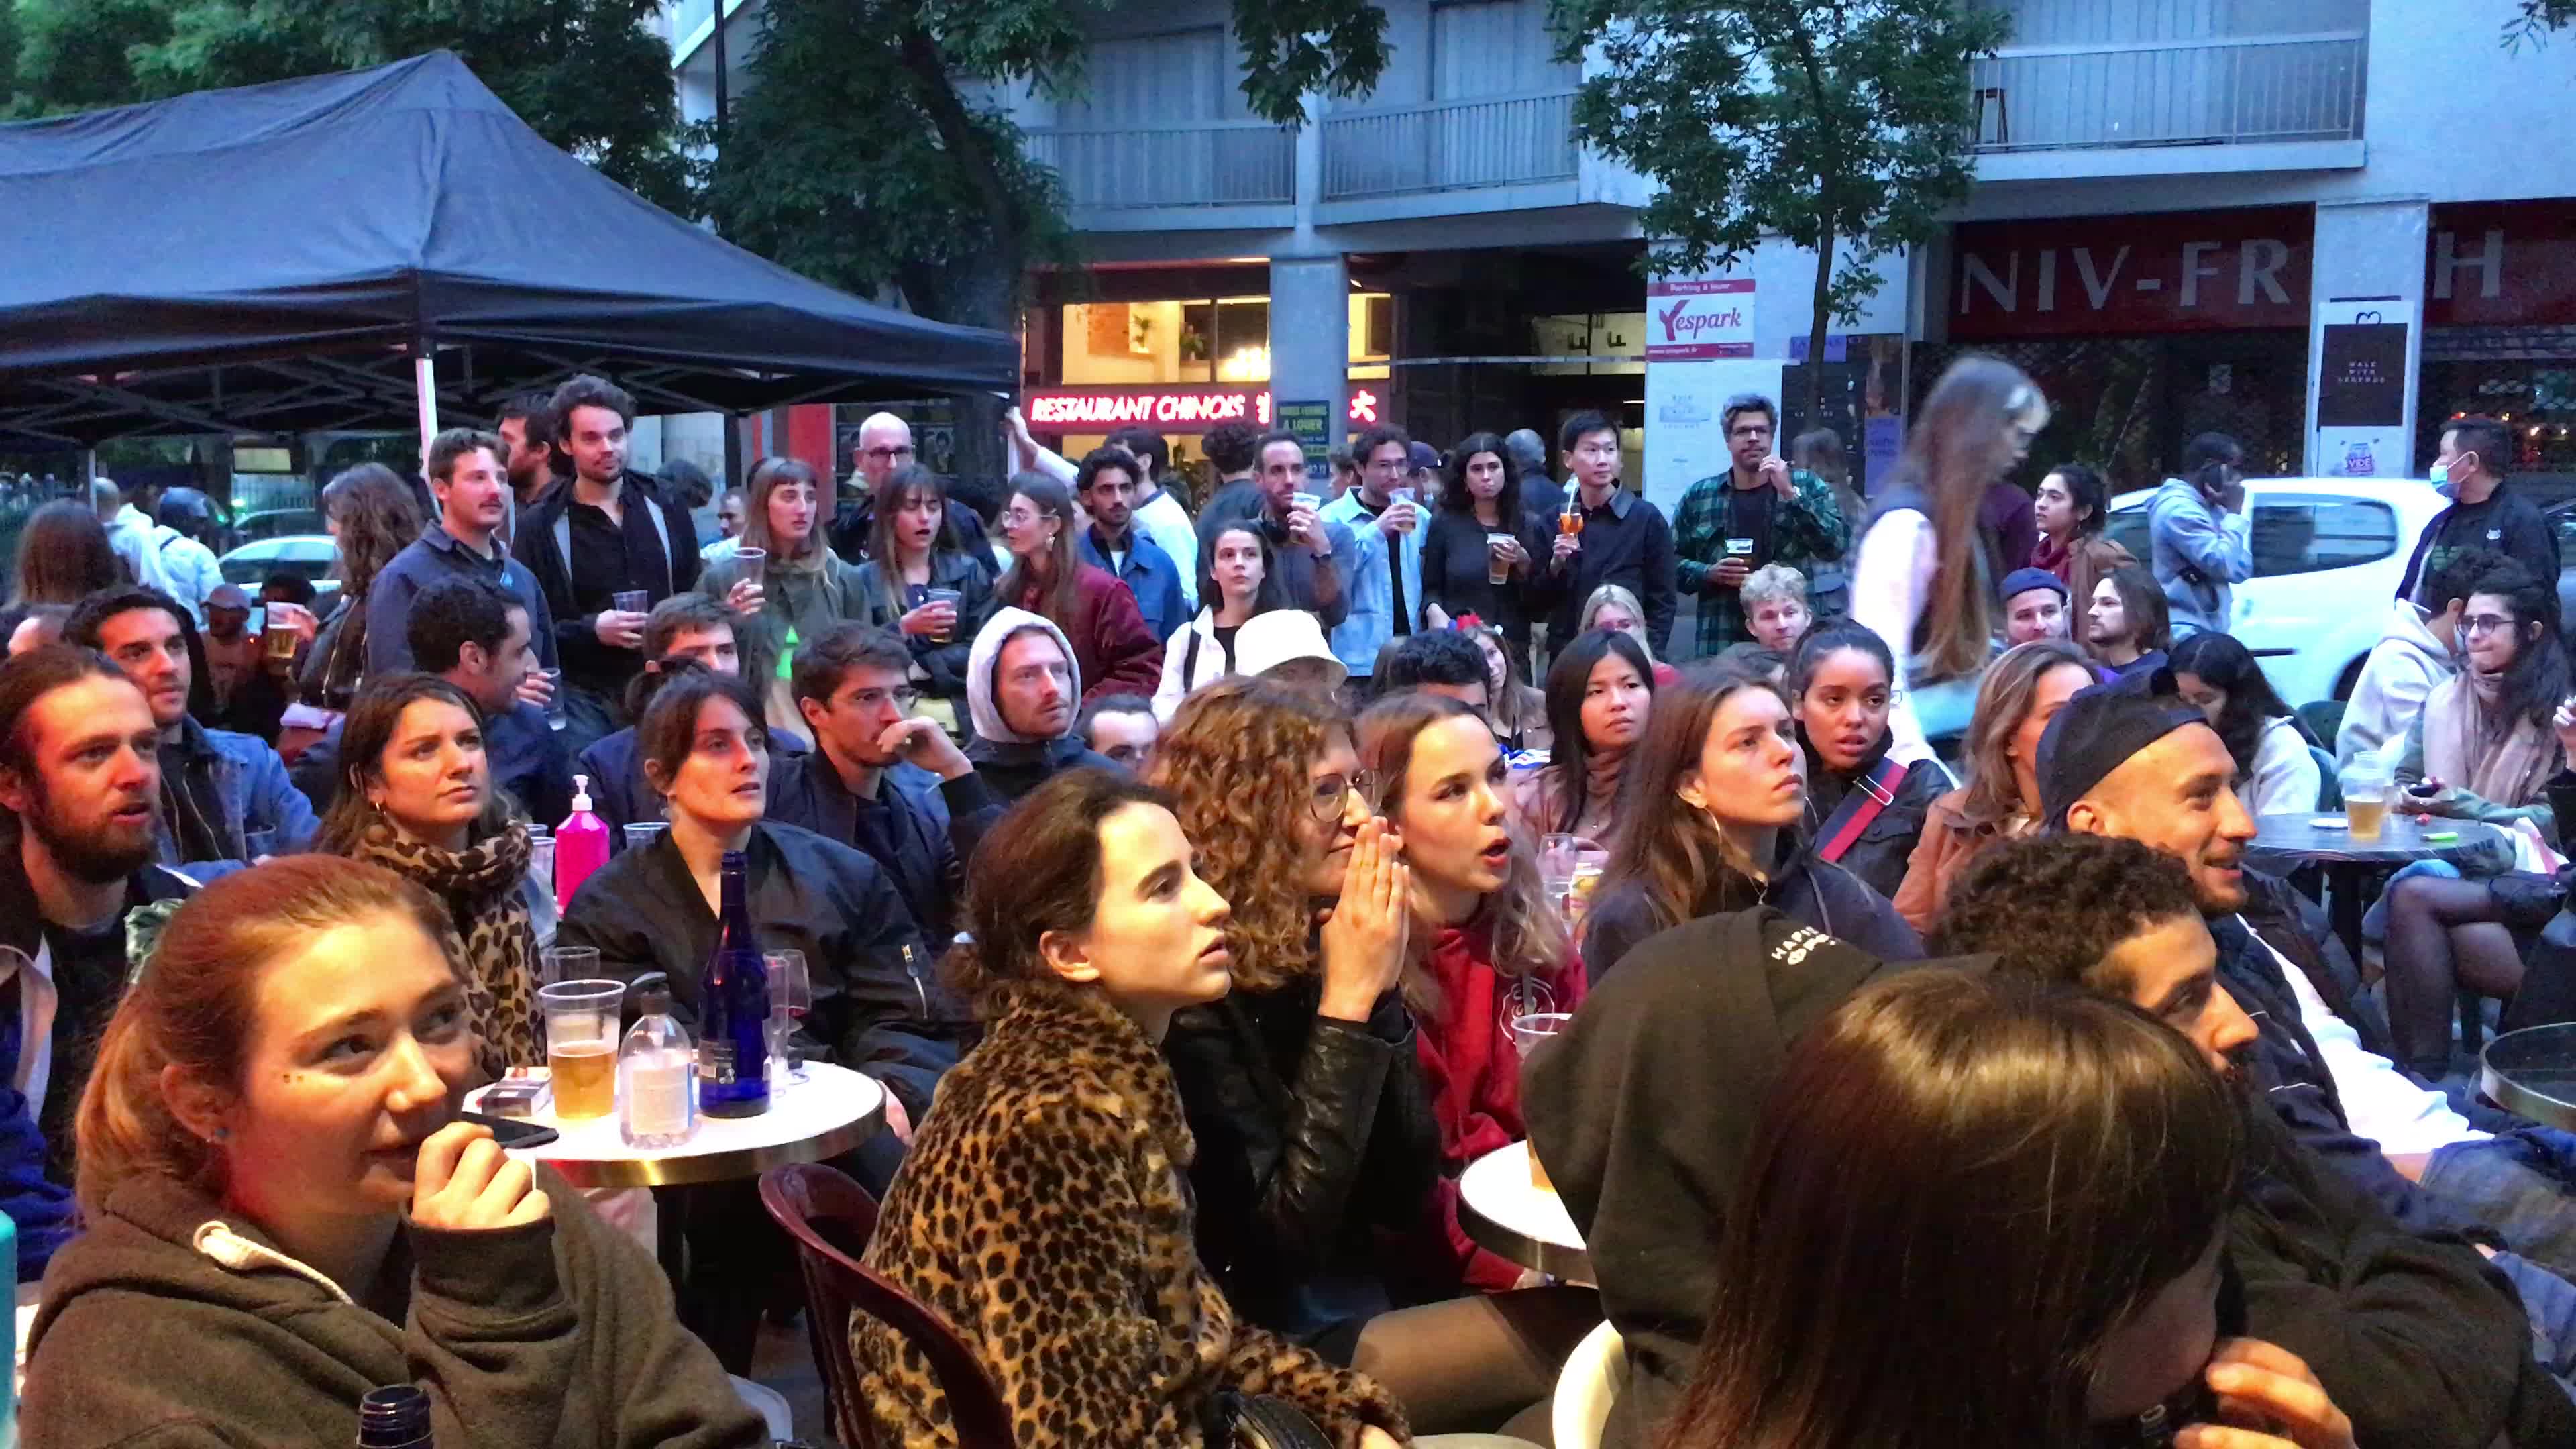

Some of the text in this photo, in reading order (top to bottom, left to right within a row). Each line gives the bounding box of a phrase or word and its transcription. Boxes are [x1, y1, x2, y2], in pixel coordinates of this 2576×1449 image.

[1659, 299, 1741, 341] Yespark
[1030, 396, 1155, 421] RESTAURANT
[1156, 394, 1246, 421] CHINOIS
